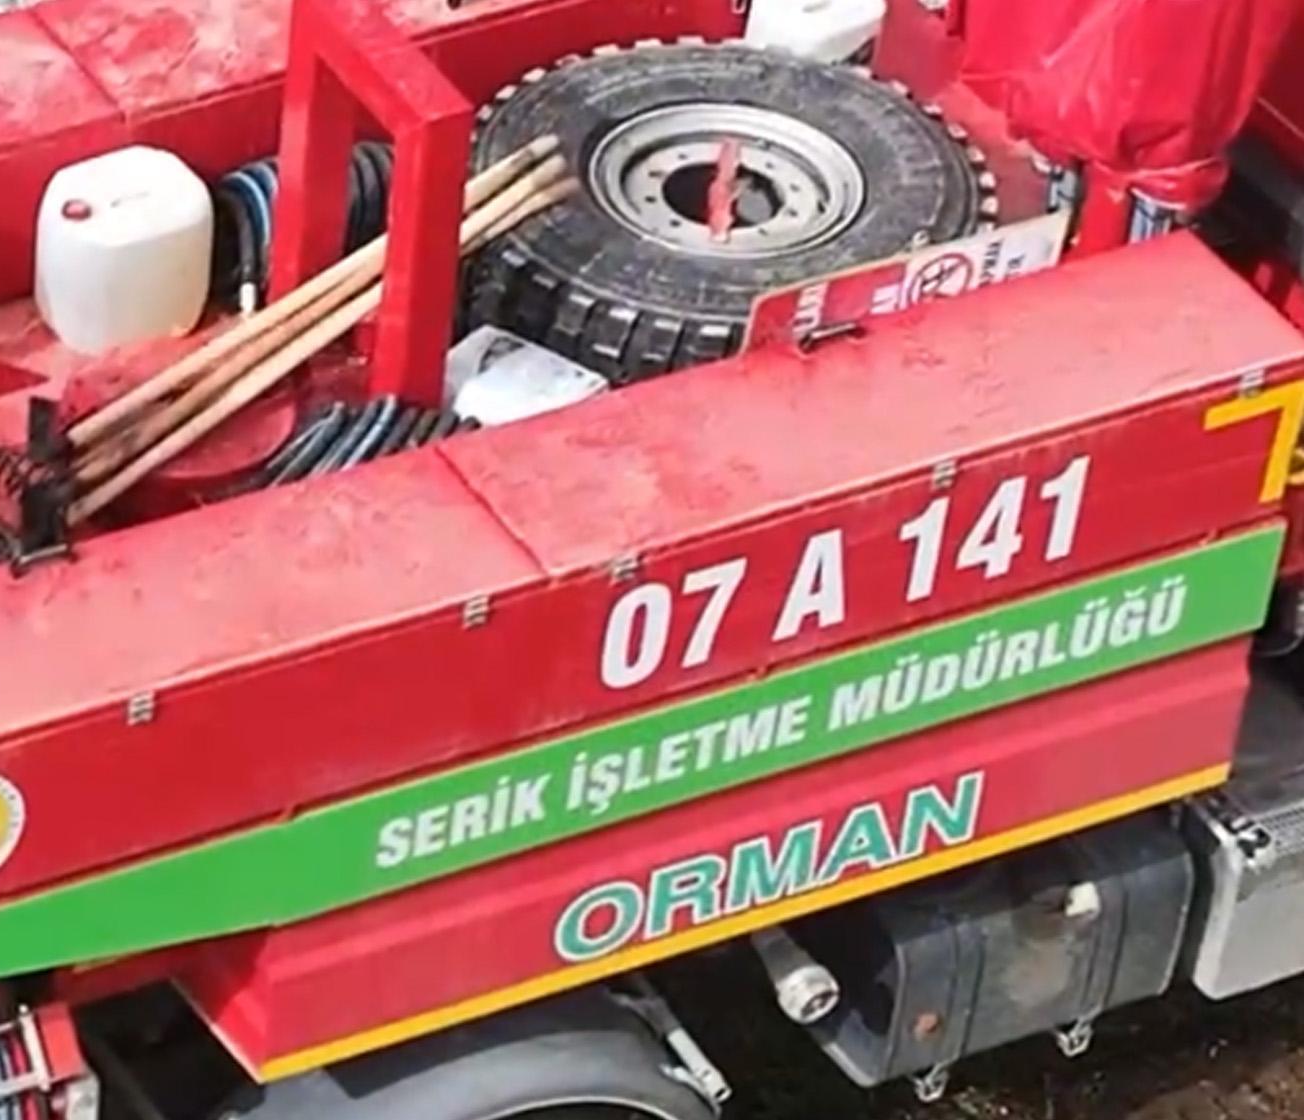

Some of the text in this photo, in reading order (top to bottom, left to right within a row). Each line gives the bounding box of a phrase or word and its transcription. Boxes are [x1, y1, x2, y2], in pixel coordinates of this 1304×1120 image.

[600, 455, 1090, 690] 07 A 141
[376, 574, 1187, 868] SERİK İŞLETME MÜDÜRLÜĞÜ
[554, 771, 984, 962] ORMAN
